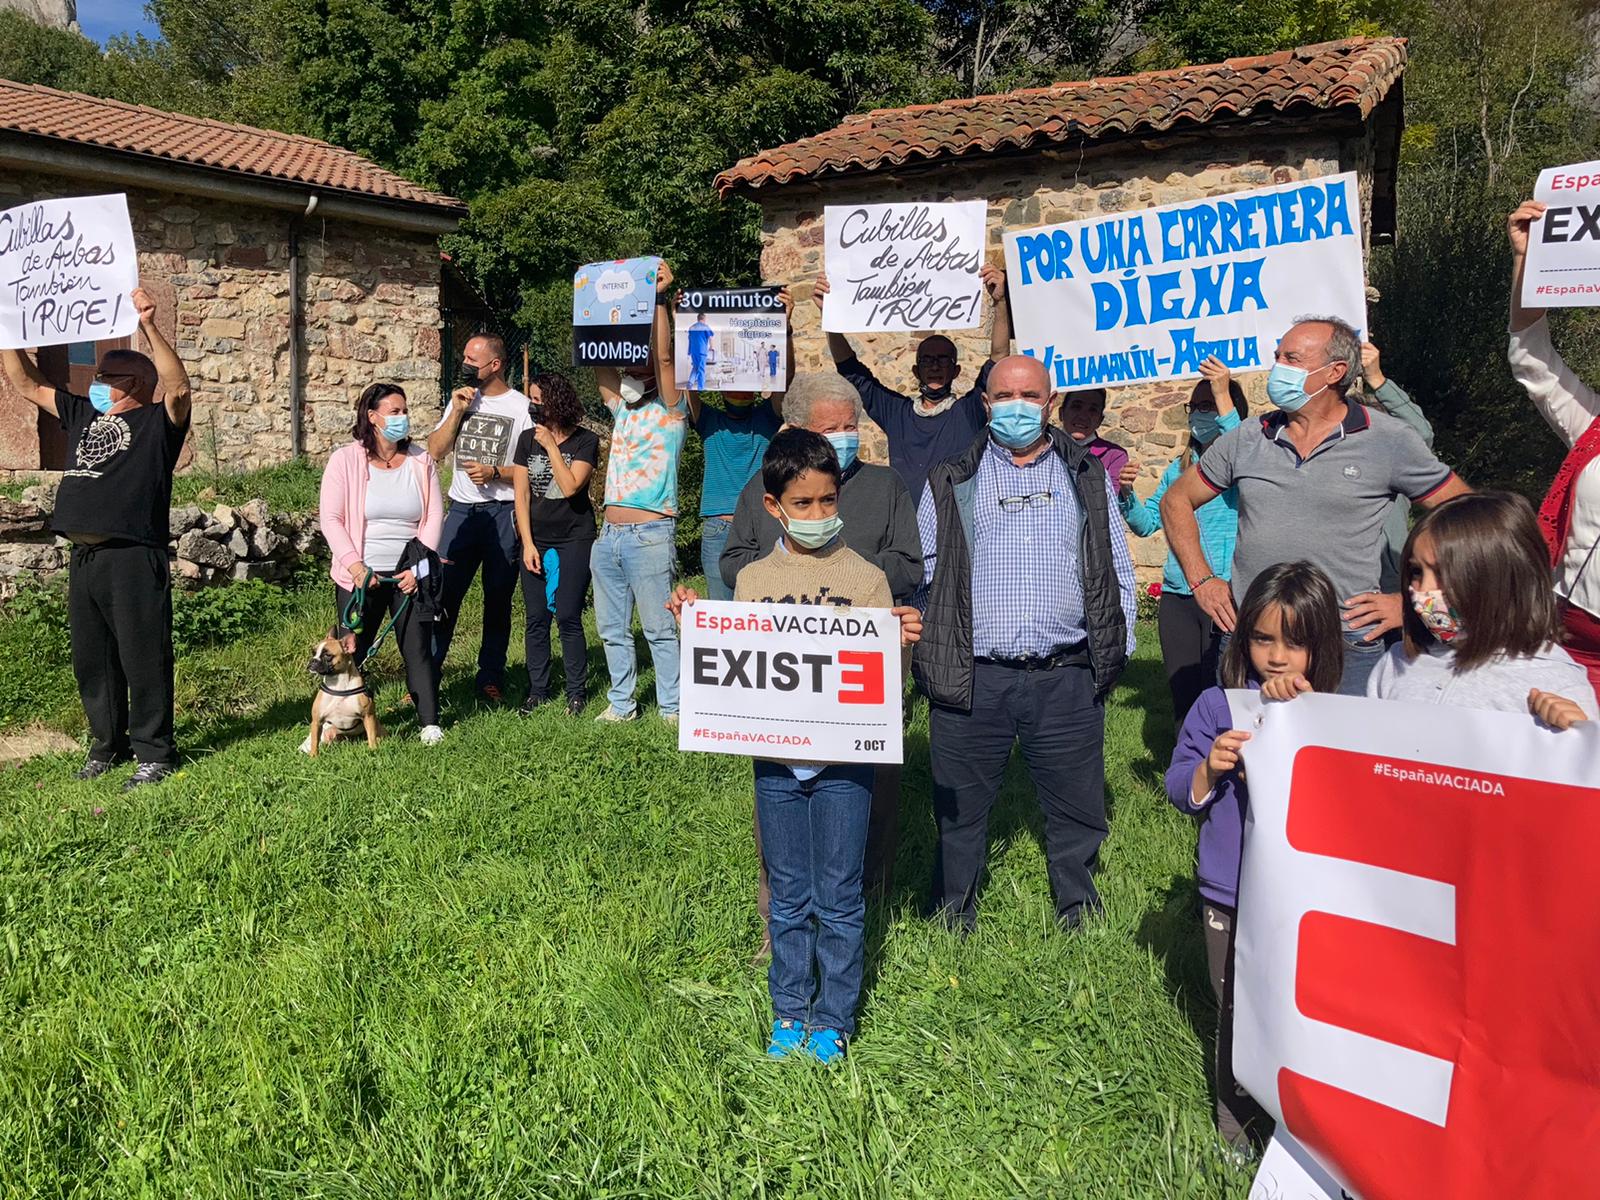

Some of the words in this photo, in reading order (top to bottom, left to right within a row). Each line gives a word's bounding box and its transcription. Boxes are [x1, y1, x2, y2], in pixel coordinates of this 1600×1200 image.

[840, 206, 947, 249] Cubillas
[1016, 230, 1074, 286] POR
[1080, 216, 1153, 275] UNA
[1157, 180, 1354, 264] CARRETERA
[22, 250, 43, 275] de
[46, 233, 115, 271] Arbas
[870, 245, 899, 270] de
[904, 236, 980, 274] Arbas
[8, 270, 100, 305] También
[602, 282, 628, 290] INTERNET
[679, 292, 702, 308] 30
[709, 291, 784, 308] minutos
[847, 268, 932, 305] También
[23, 293, 122, 340] ¡RUGE!
[729, 317, 781, 329] Hospitales
[866, 290, 981, 328] ¡RUGE!
[738, 329, 772, 339] dignos
[579, 341, 649, 363] 100MBps
[460, 438, 499, 453] YORK
[696, 611, 880, 638] EspañaVACIADA
[693, 727, 812, 747] #EspañaVACIADA
[854, 739, 862, 751] 2
[864, 739, 886, 752] OCT
[1373, 762, 1506, 797] #EspañaVACIADA
